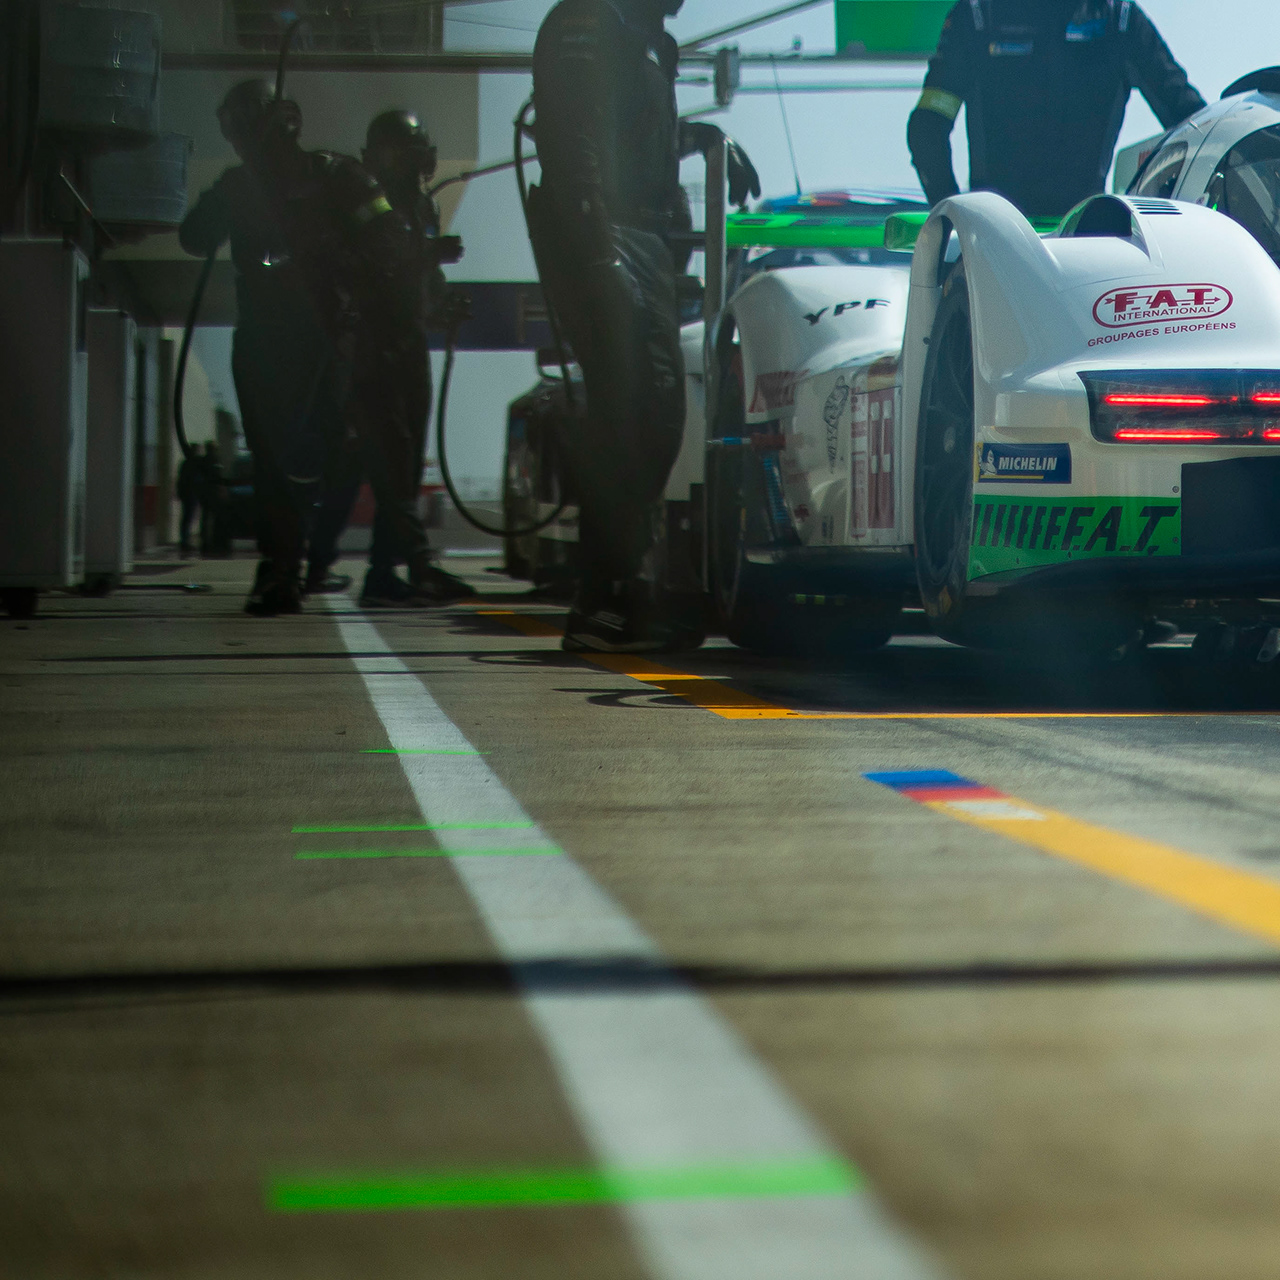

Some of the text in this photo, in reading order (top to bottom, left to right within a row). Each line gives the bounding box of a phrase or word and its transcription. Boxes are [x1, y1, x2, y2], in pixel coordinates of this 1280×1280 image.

[803, 299, 891, 326] YPF
[1114, 306, 1215, 322] INTERNATIONAL
[1087, 322, 1237, 347] GROUPAGES EUROPÉENS
[998, 456, 1058, 471] MICHELIN
